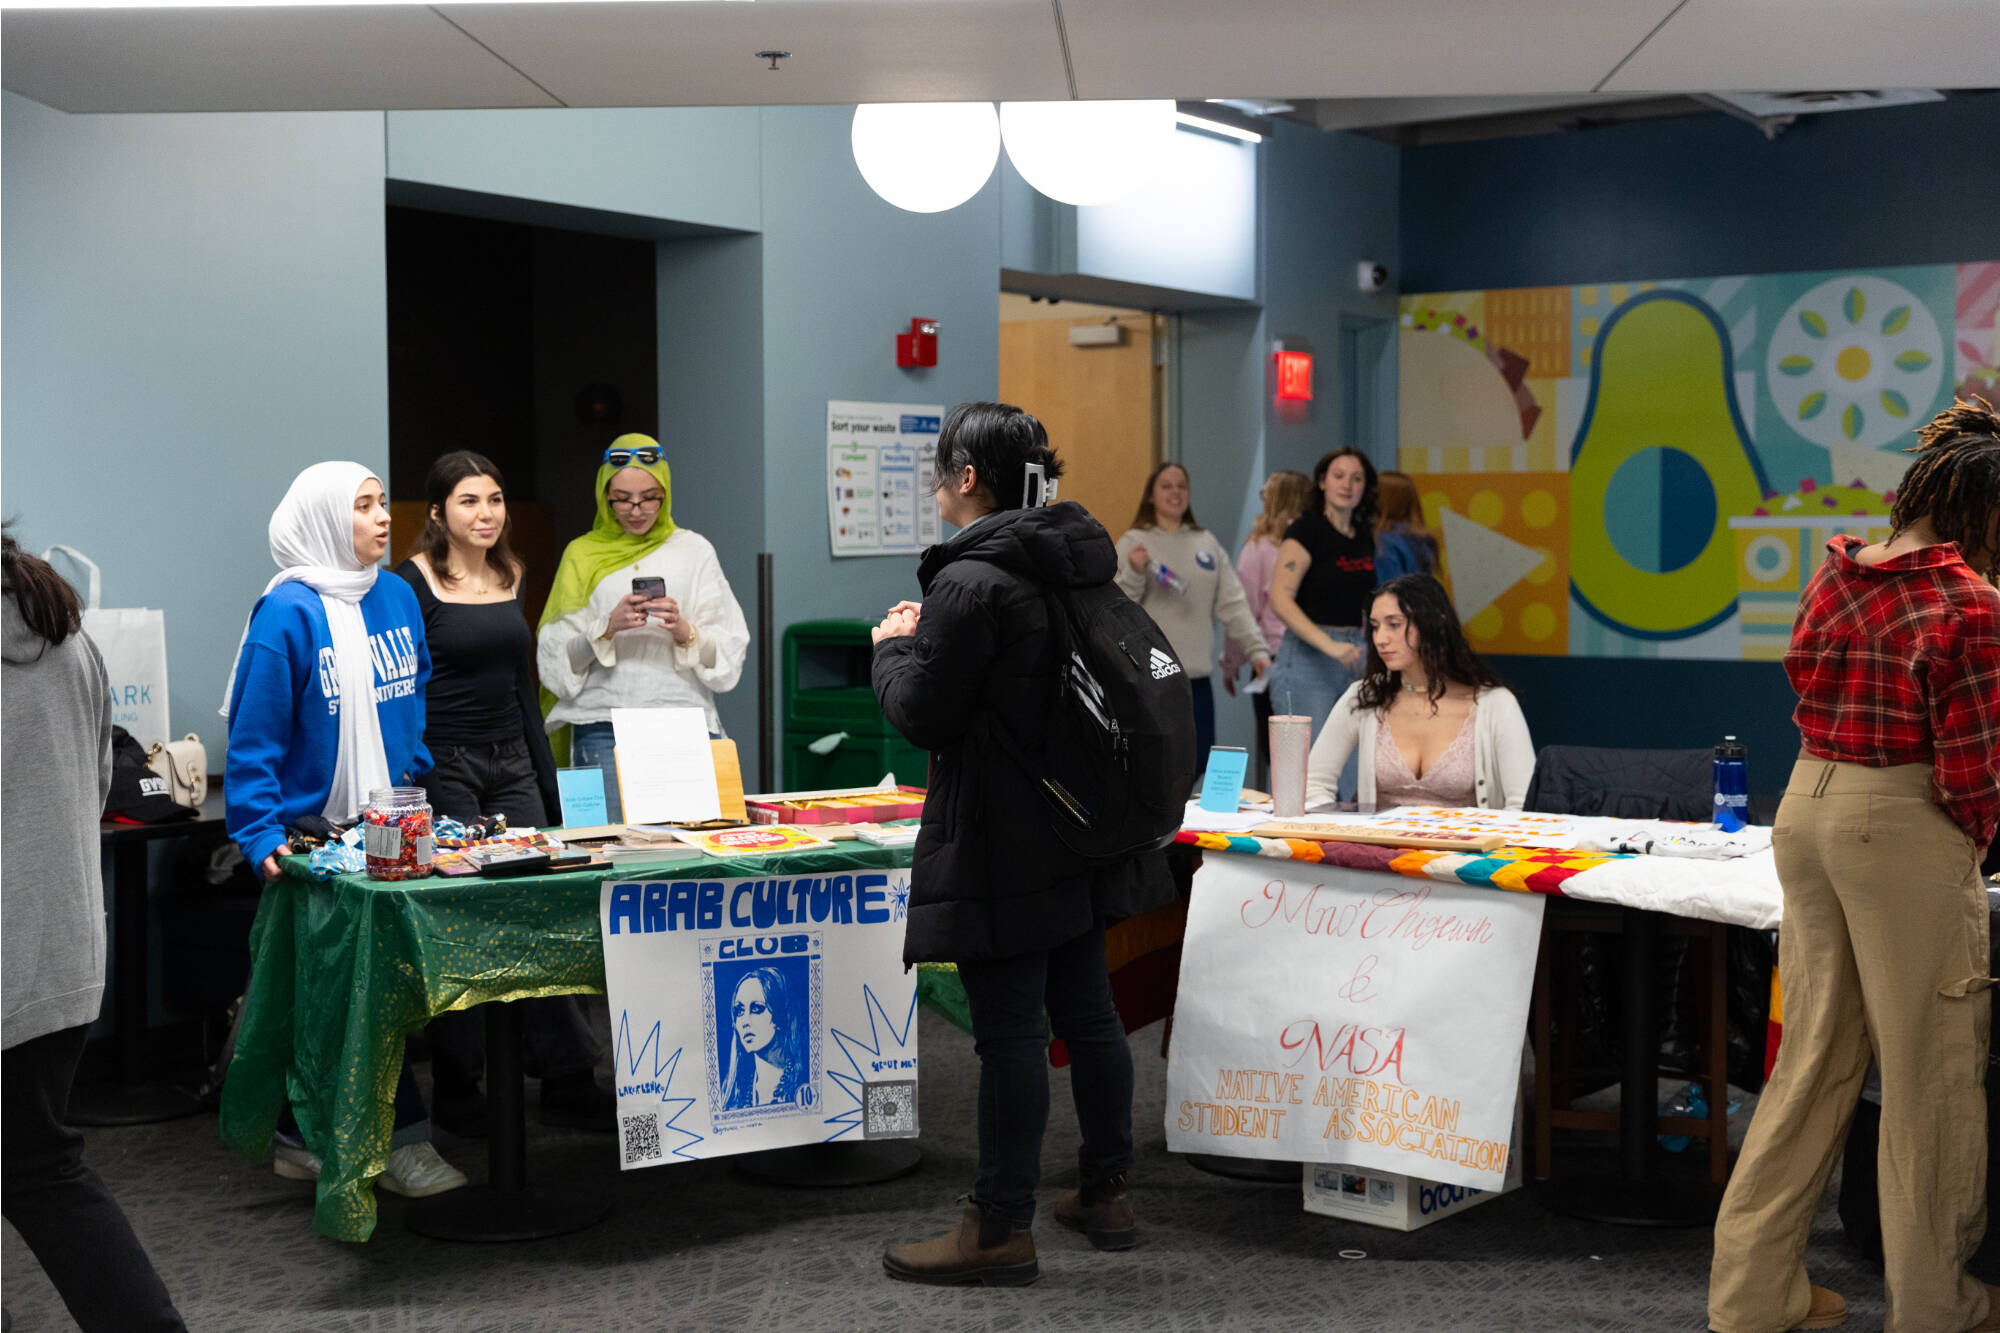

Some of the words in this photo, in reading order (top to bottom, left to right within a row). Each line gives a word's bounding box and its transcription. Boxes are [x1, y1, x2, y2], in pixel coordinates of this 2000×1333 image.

[831, 421, 849, 432] Sort
[851, 423, 870, 434] your
[872, 424, 896, 433] waste
[1151, 663, 1181, 680] adidas
[610, 881, 725, 935] ARAB
[729, 874, 890, 929] CULTURE
[718, 934, 810, 959] CLUB
[1338, 954, 1378, 1003] &
[1280, 1019, 1413, 1086] NASA
[801, 1086, 813, 1107] 10
[1215, 1068, 1304, 1105] NATIVE
[1312, 1075, 1461, 1132] AMERICAN
[1177, 1102, 1287, 1139] STUDENT
[1323, 1108, 1508, 1174] ASSOCIATION
